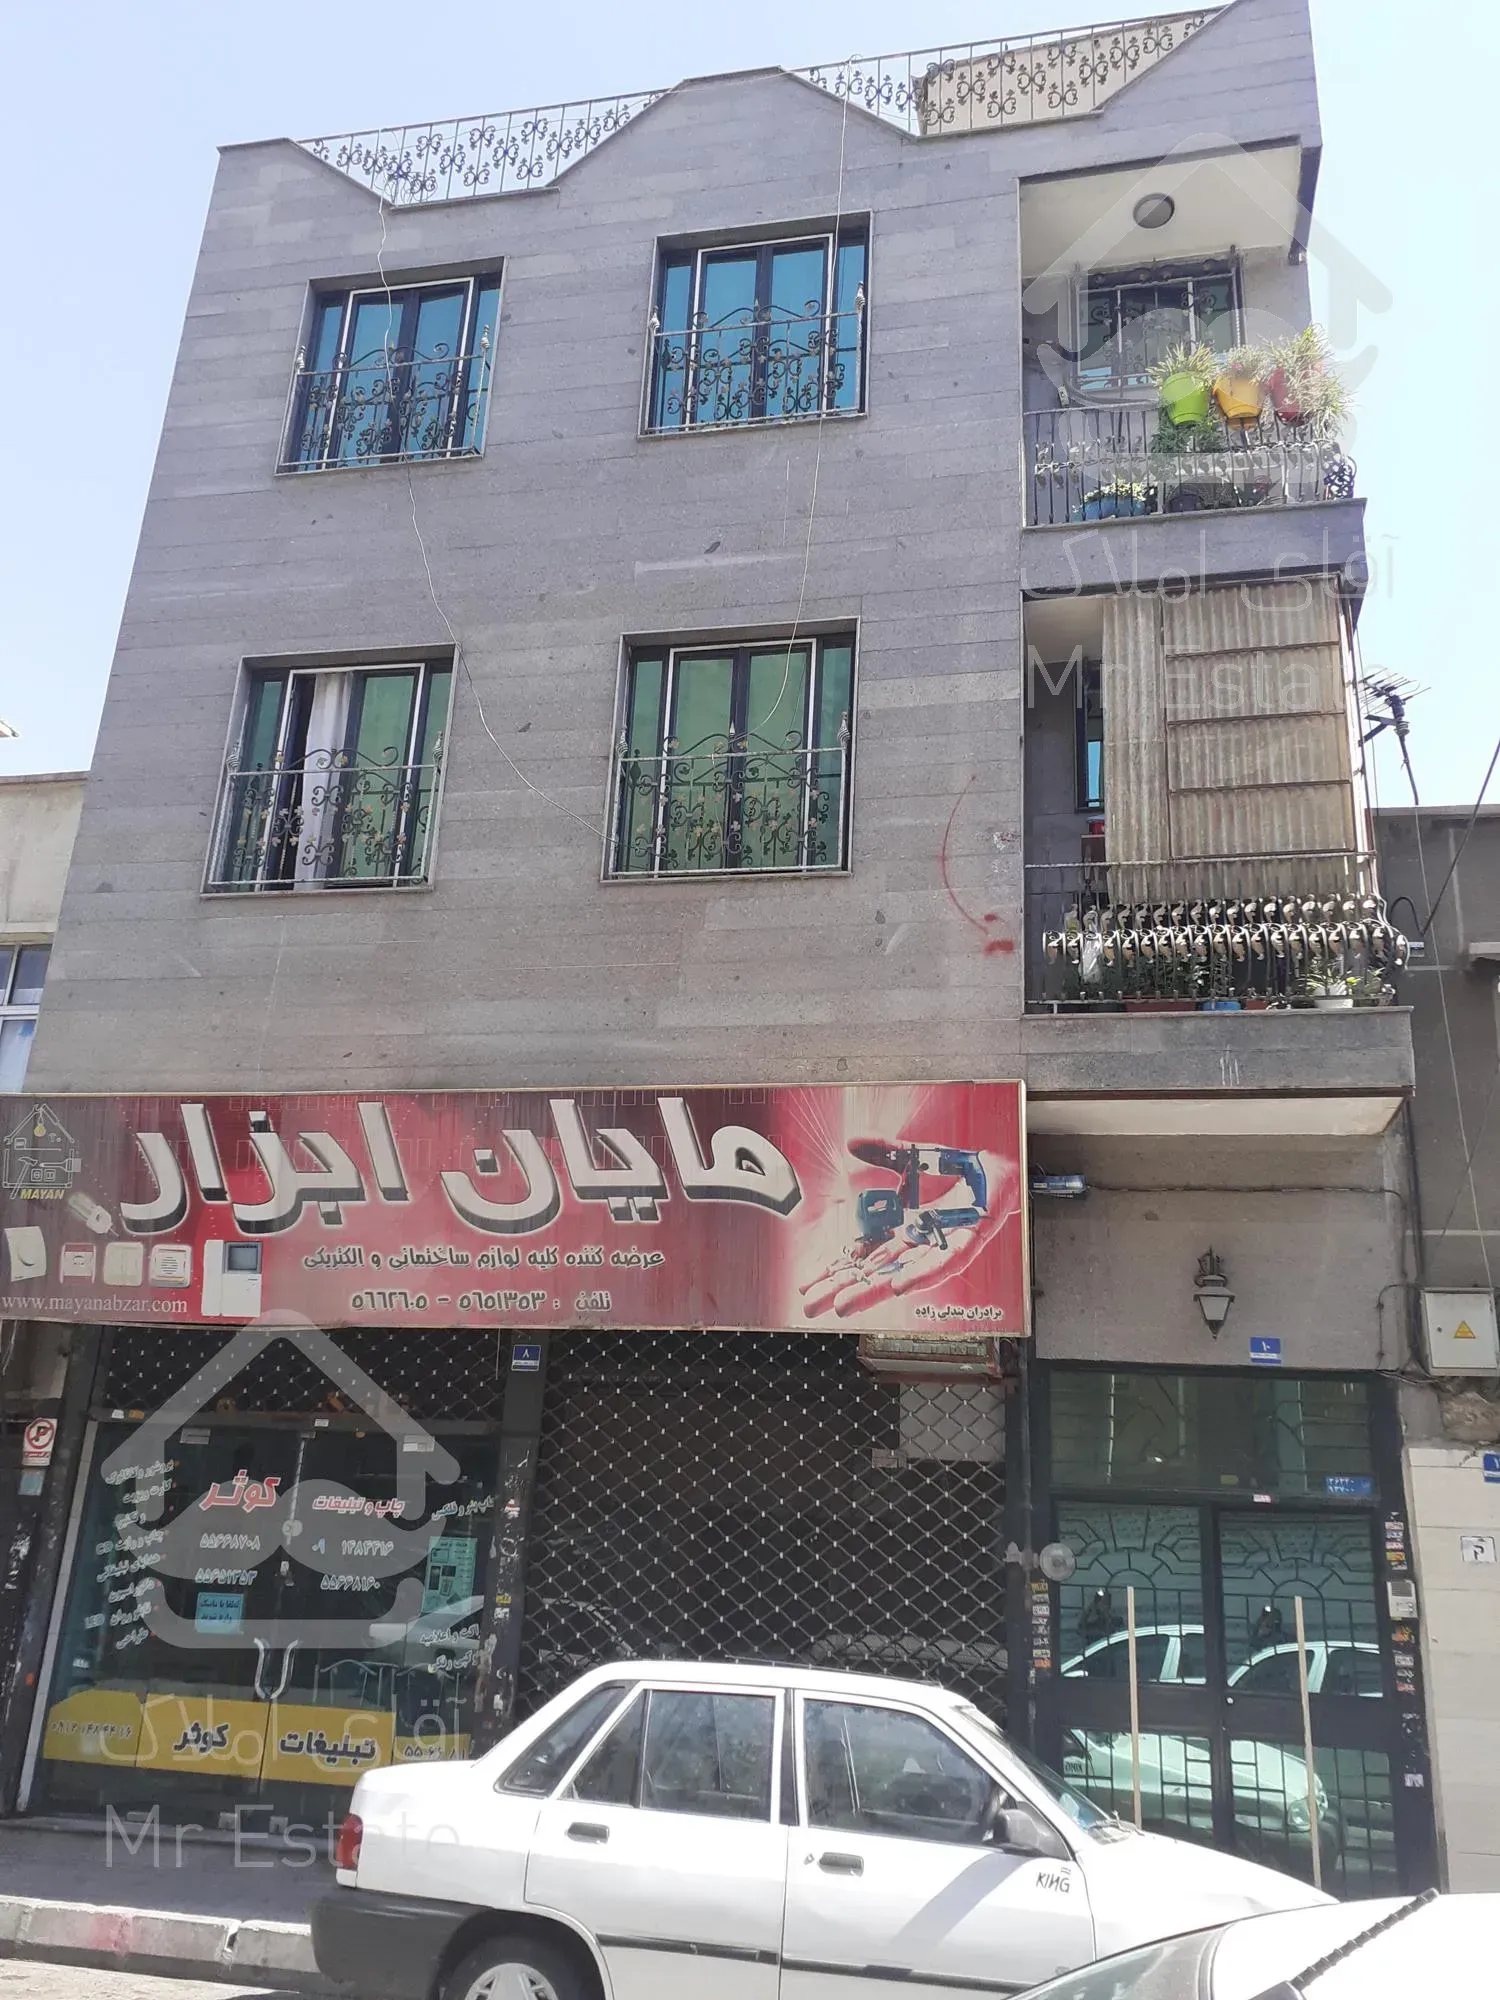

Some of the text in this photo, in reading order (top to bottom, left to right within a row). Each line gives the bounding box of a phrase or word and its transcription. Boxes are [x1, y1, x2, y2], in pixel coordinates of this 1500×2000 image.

[119, 1097, 802, 1236] مایان ابزار
[20, 1188, 65, 1200] MAYAN
[303, 1245, 665, 1271] عرضه کننده کلیه لوازم ساختمانی و الکتریکی
[1, 1295, 188, 1314] www.mayanabzar.com
[574, 1291, 612, 1312] تلفن
[915, 1304, 936, 1321] زاده
[966, 1304, 1003, 1321] برادران
[199, 1469, 281, 1513] کوثر
[311, 1495, 406, 1519] چاپ و تبلیغات
[174, 1721, 229, 1756] کوثر
[279, 1730, 376, 1767] تبلیغات
